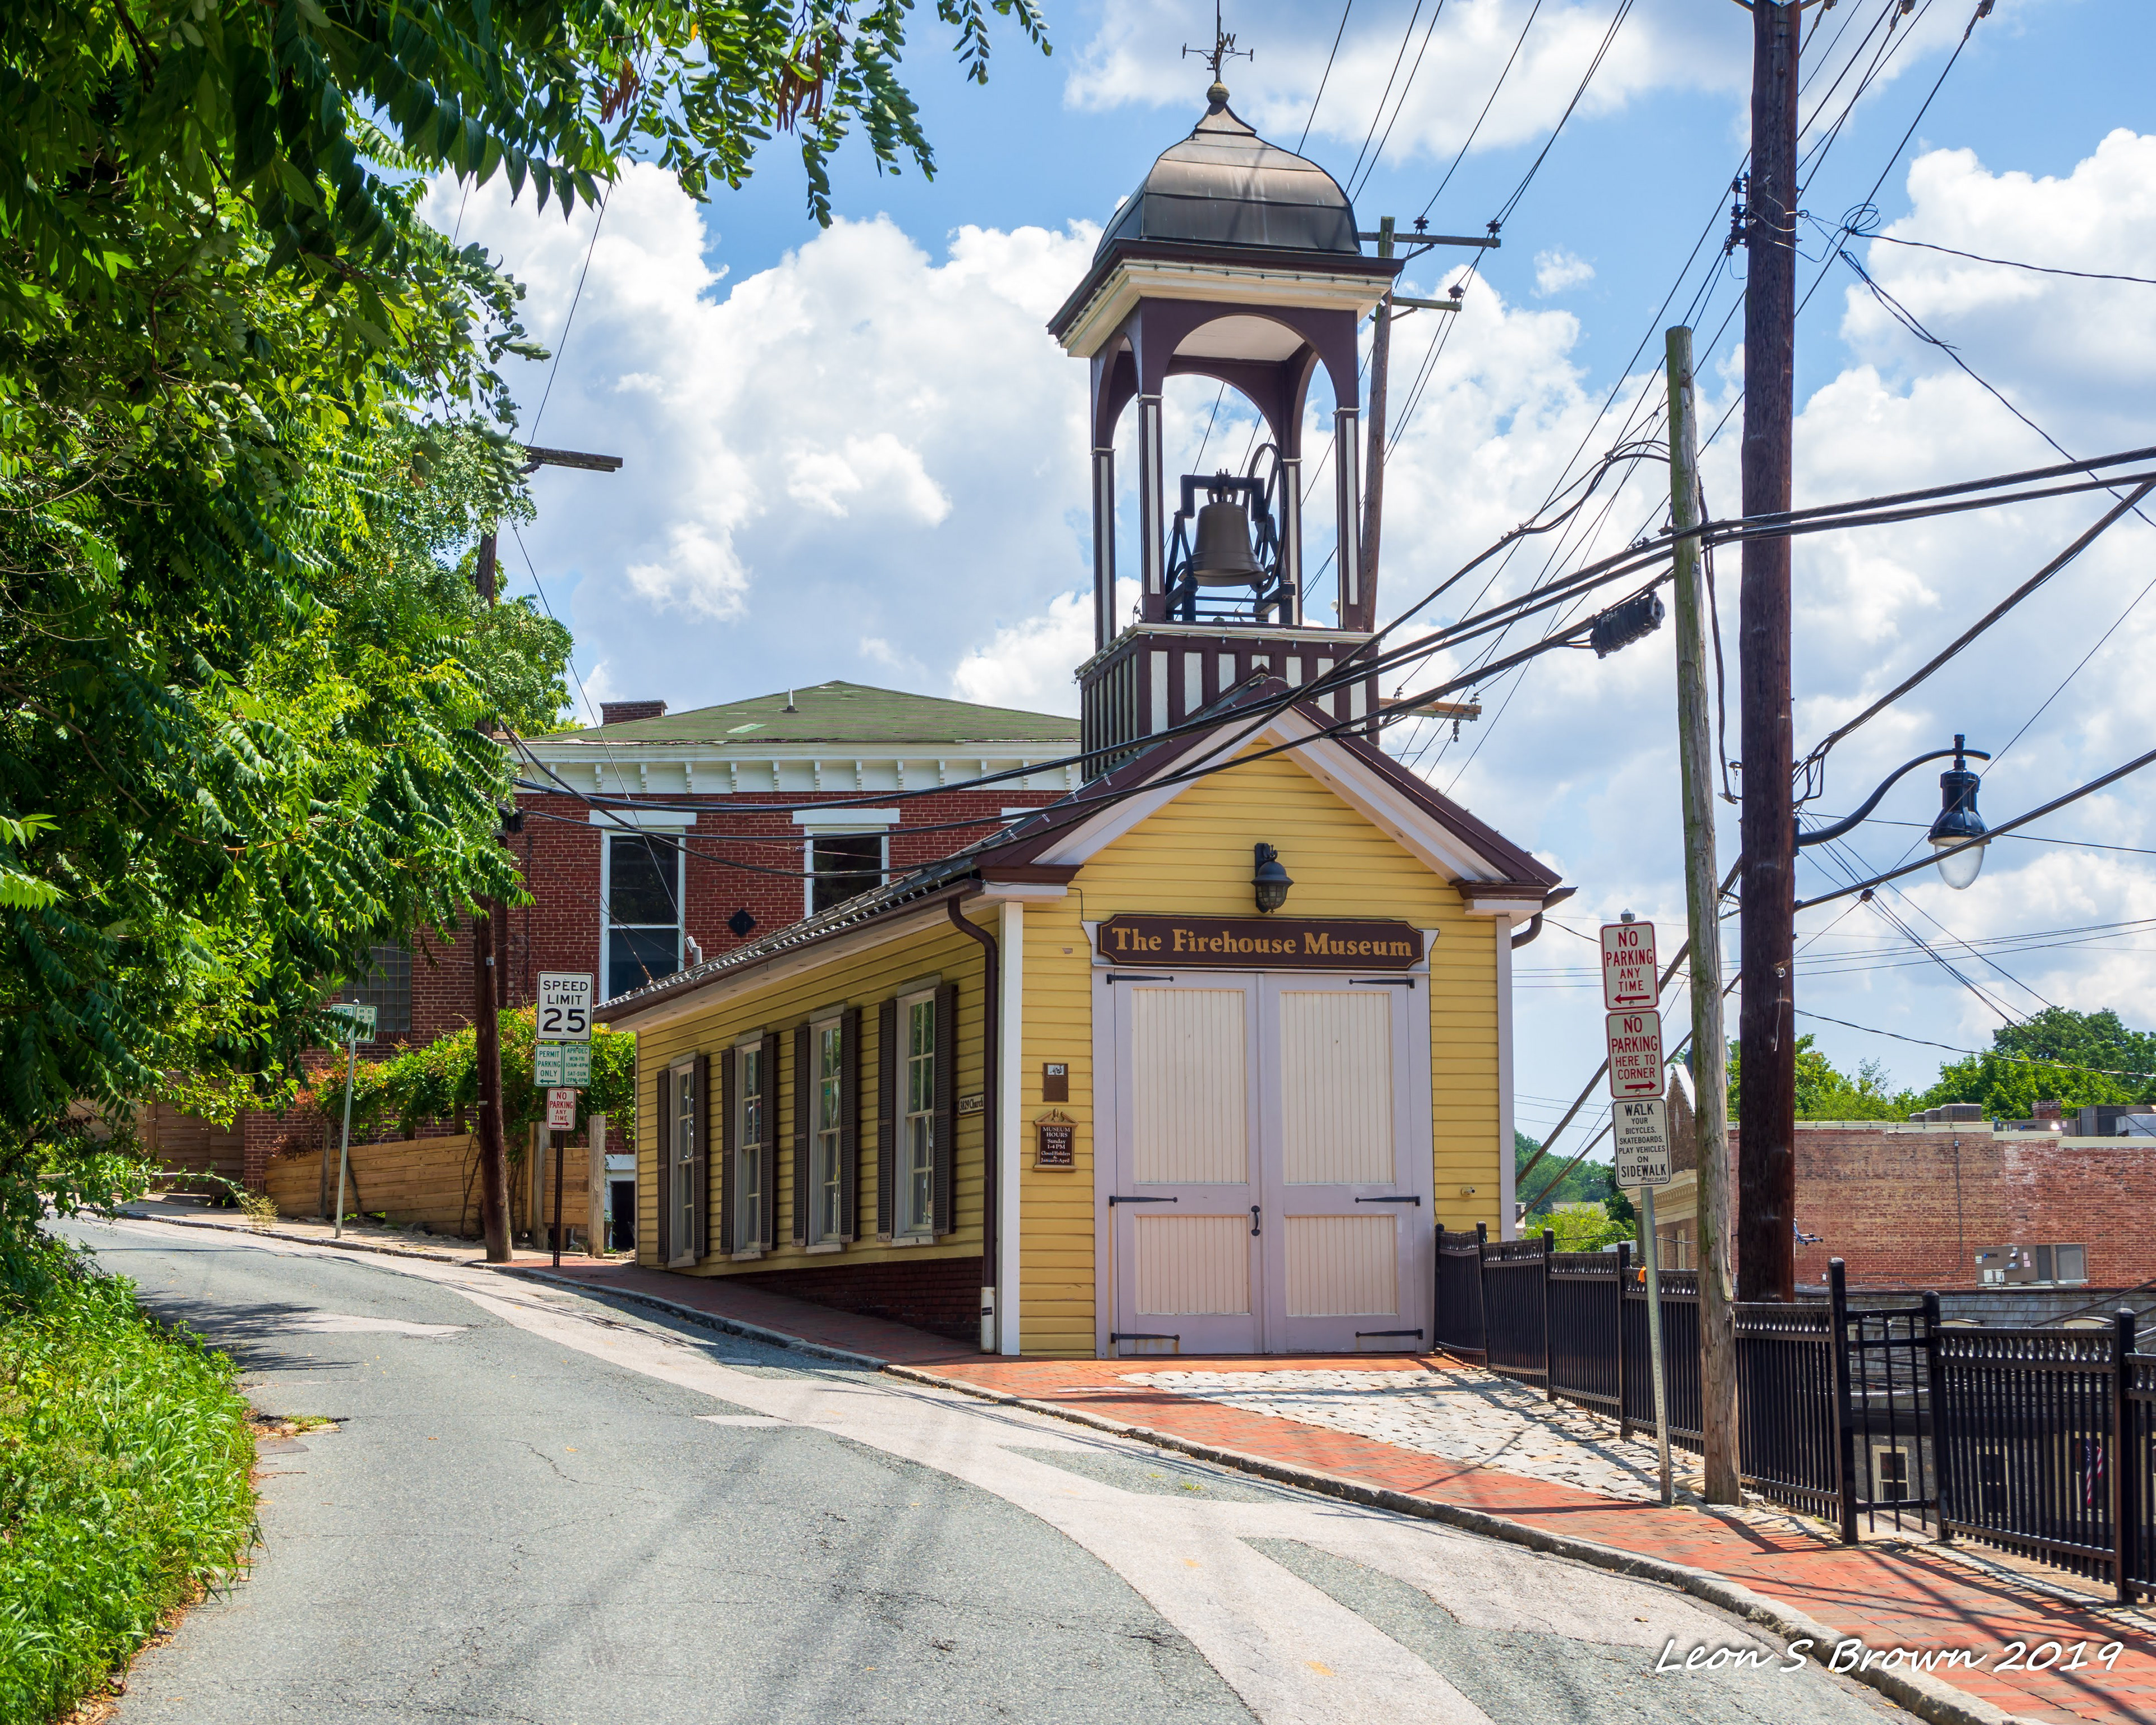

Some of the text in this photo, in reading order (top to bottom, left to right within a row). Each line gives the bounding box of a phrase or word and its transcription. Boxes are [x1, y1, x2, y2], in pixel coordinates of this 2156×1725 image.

[1112, 927, 1412, 957] The Firehouse Museum
[1618, 930, 1638, 947] NO
[1606, 948, 1653, 967] PARKING
[1620, 968, 1640, 979] ANY
[543, 980, 588, 991] SPEED
[1618, 980, 1644, 992] TIME
[547, 994, 583, 1005] LIMIT
[542, 1008, 586, 1033] 25
[1624, 1017, 1642, 1033] NO
[1611, 1035, 1657, 1053] PARKING
[1615, 1054, 1656, 1067] HERE TO
[1618, 1067, 1655, 1080] CORNER
[550, 1101, 573, 1109] PARKING
[1624, 1103, 1654, 1116] WALK
[1636, 1145, 1666, 1153] VEHICLES
[1621, 1163, 1666, 1178] SIDEWALK
